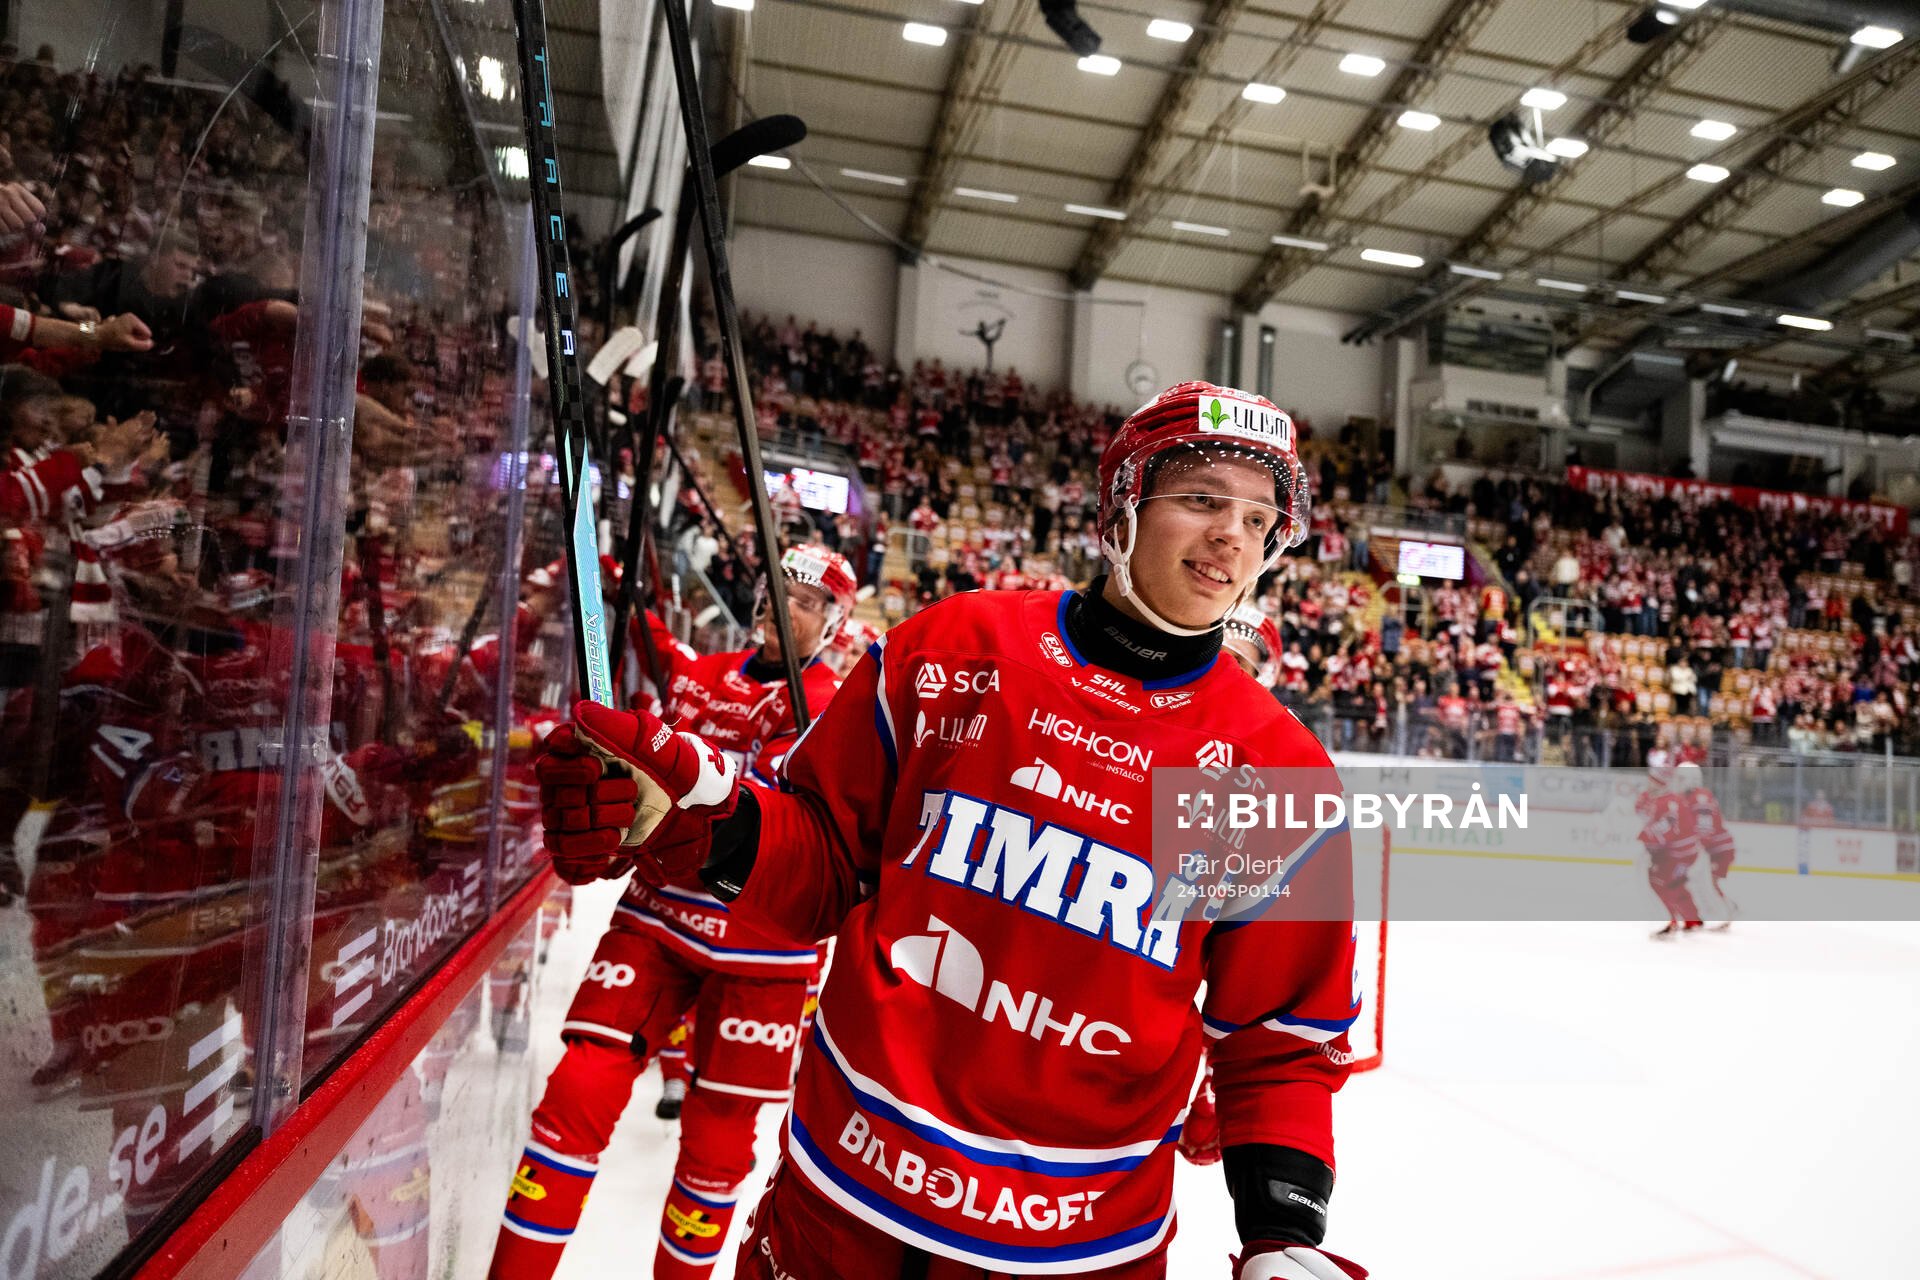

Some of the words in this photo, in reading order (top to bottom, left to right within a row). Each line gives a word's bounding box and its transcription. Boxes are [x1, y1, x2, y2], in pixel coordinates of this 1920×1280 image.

[953, 669, 1000, 694] SCA
[1089, 673, 1127, 696] SHL
[1027, 707, 1153, 772] HIGHCON
[1105, 764, 1145, 783] INSTALCO
[1061, 784, 1134, 825] NHC
[900, 790, 1206, 971] TIMRÅ
[720, 1017, 796, 1053] coop
[982, 979, 1132, 1055] NHC
[838, 1110, 1106, 1231] BILBOLAGET
[1287, 1192, 1328, 1217] BAUER
